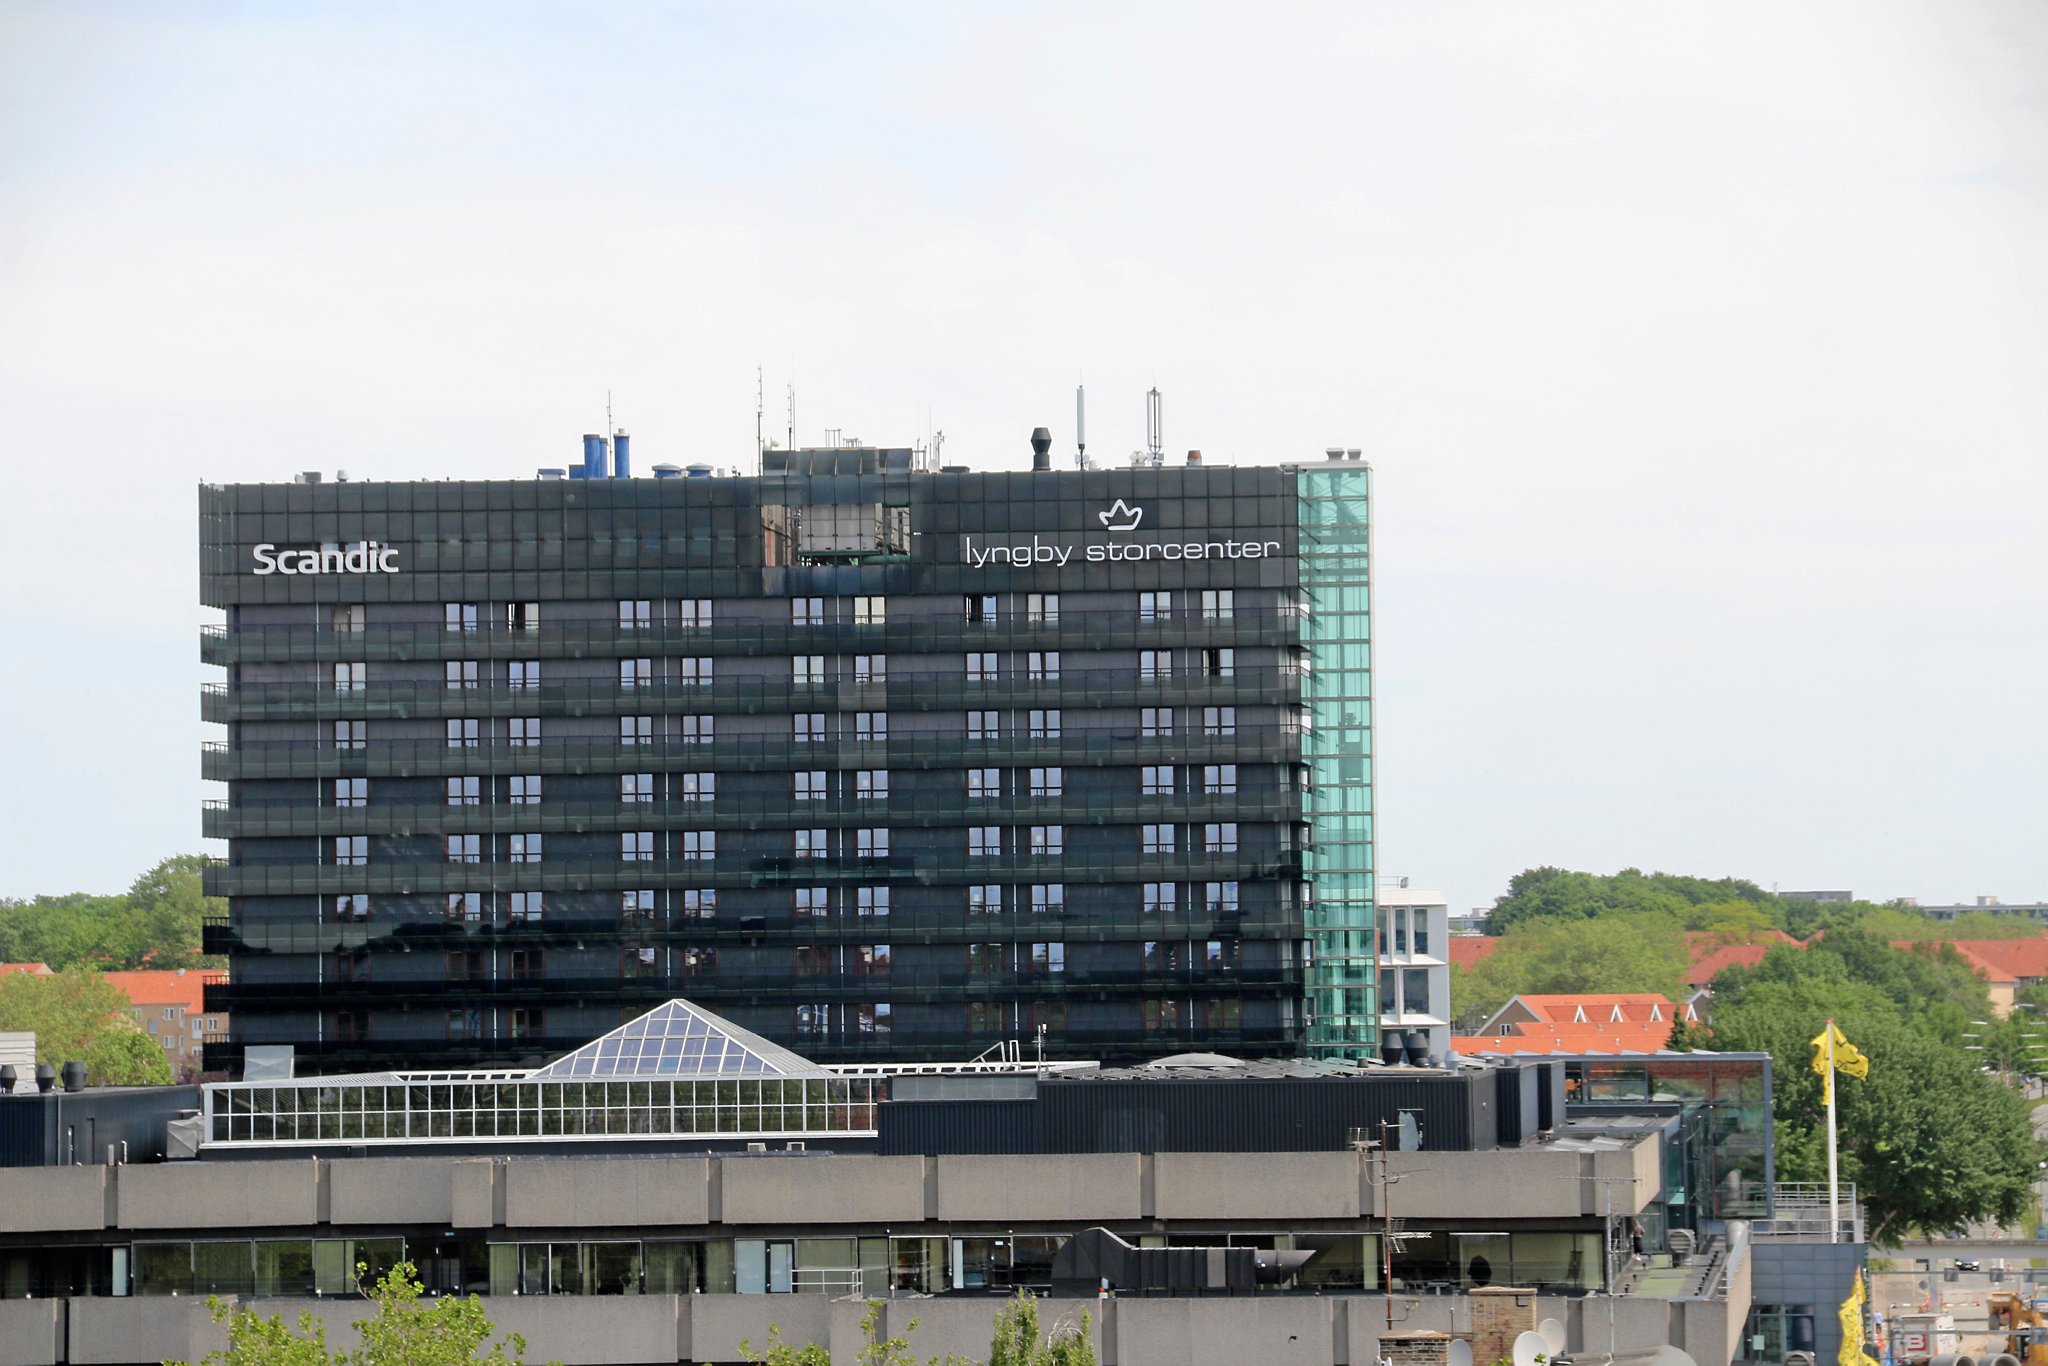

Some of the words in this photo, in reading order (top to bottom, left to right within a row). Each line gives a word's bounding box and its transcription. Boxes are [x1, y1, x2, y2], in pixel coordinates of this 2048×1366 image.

[253, 540, 400, 575] Scandic
[966, 535, 1073, 568] lyngby
[1086, 539, 1280, 562] storcenter
